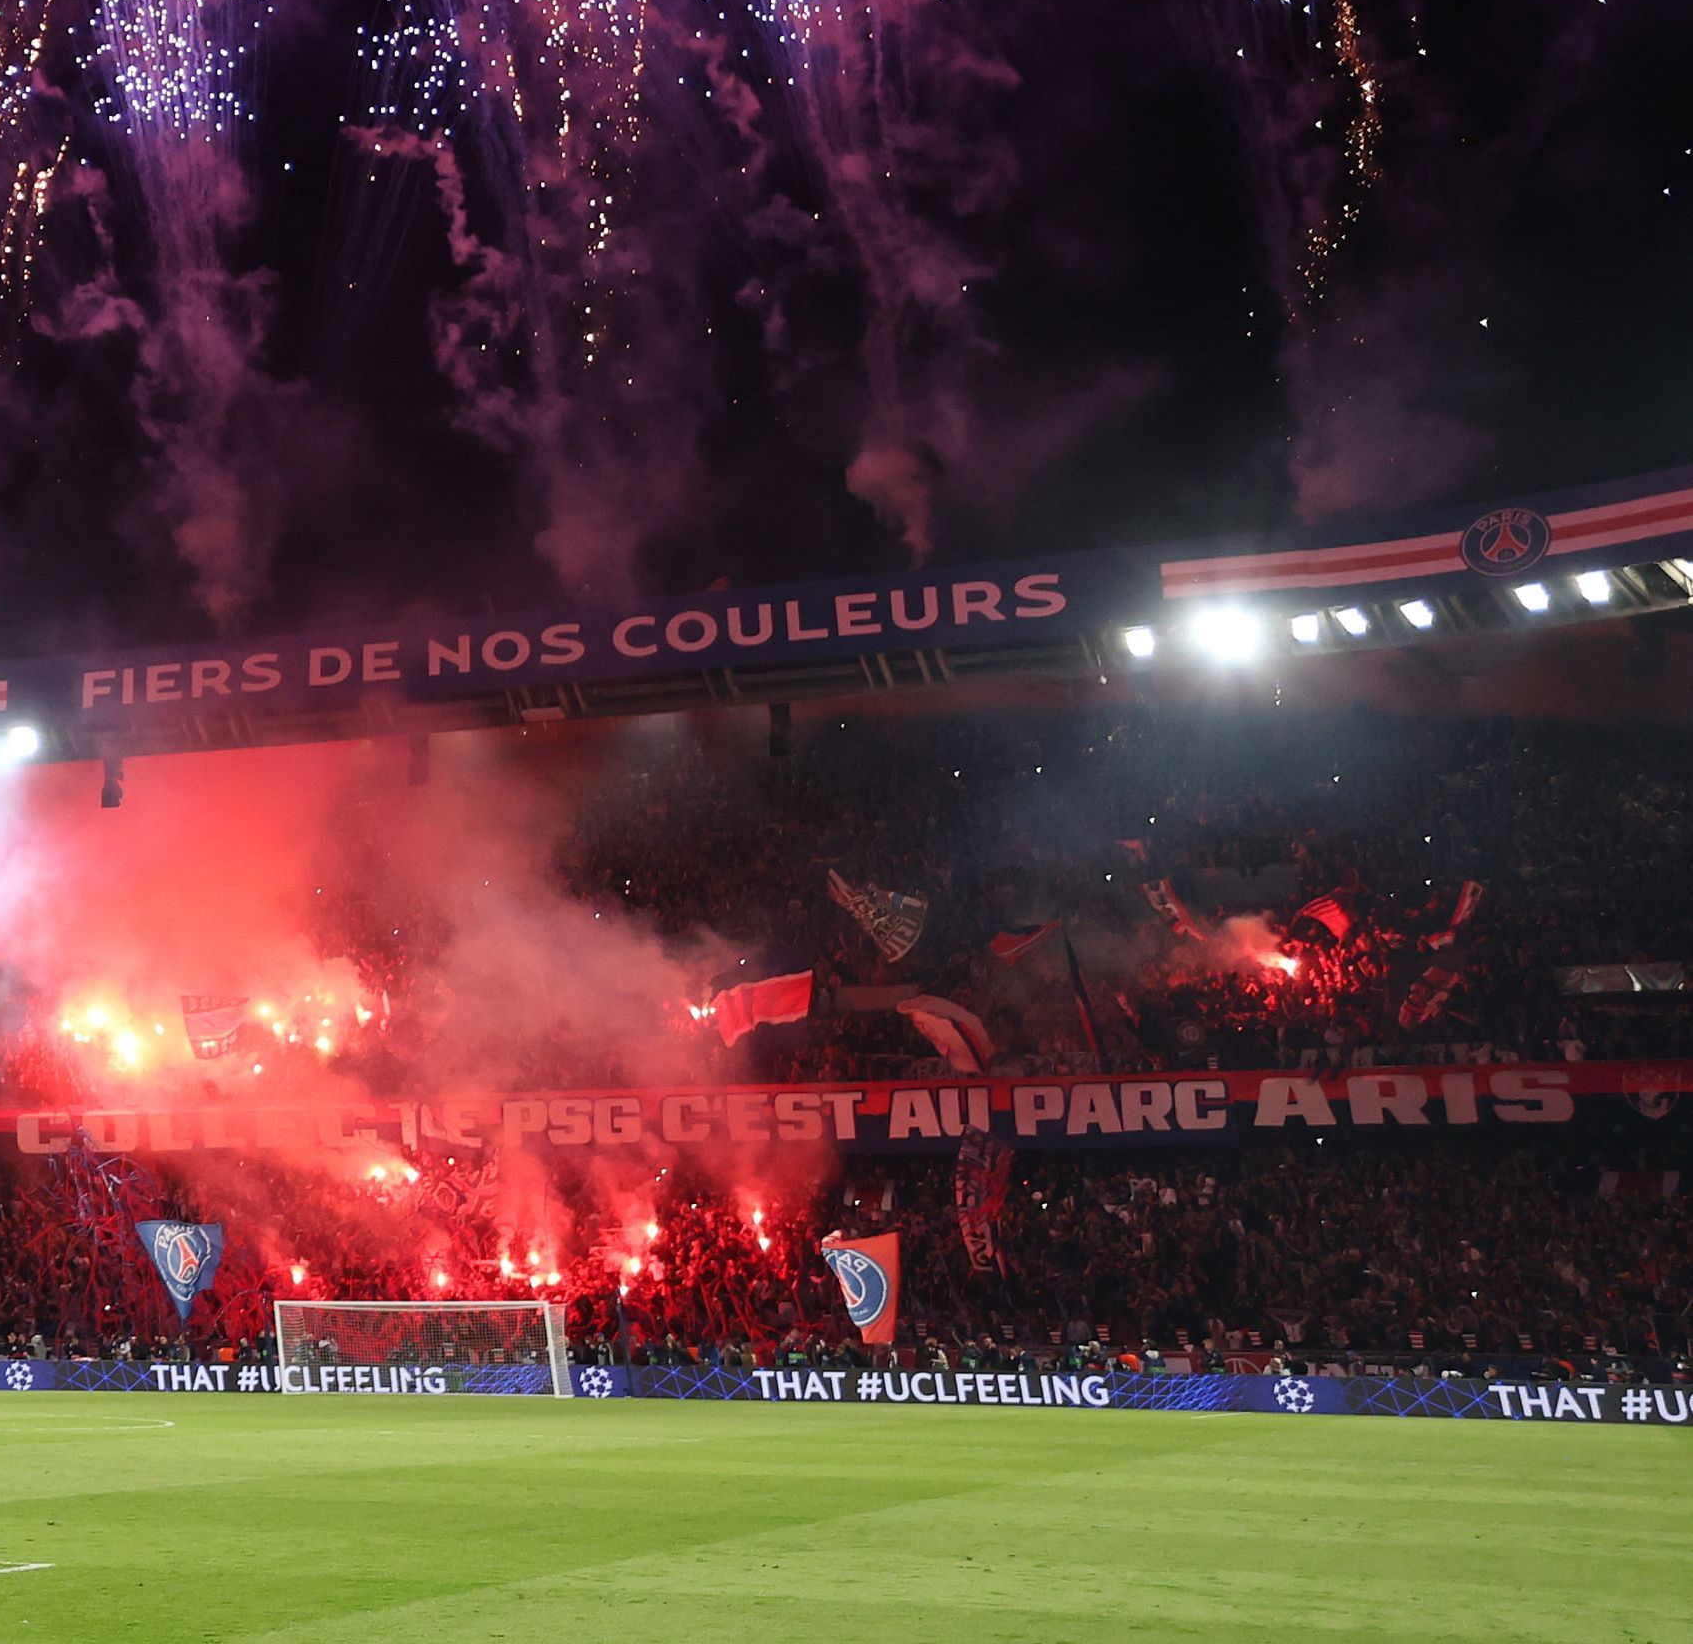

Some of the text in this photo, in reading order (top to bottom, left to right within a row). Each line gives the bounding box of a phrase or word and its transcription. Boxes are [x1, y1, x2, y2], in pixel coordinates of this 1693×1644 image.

[82, 572, 1067, 708] FIERS DE NOS COULEURS
[503, 1096, 641, 1145] PSG
[661, 1091, 863, 1143] C'EST
[888, 1087, 991, 1139] AU
[1015, 1079, 1226, 1136] PARC
[1254, 1069, 1574, 1127] ARIS
[150, 1364, 445, 1394] THAT #UCLFEELING
[754, 1370, 1110, 1407] THAT #UCLFEELING
[1488, 1384, 1693, 1423] THAT #U
